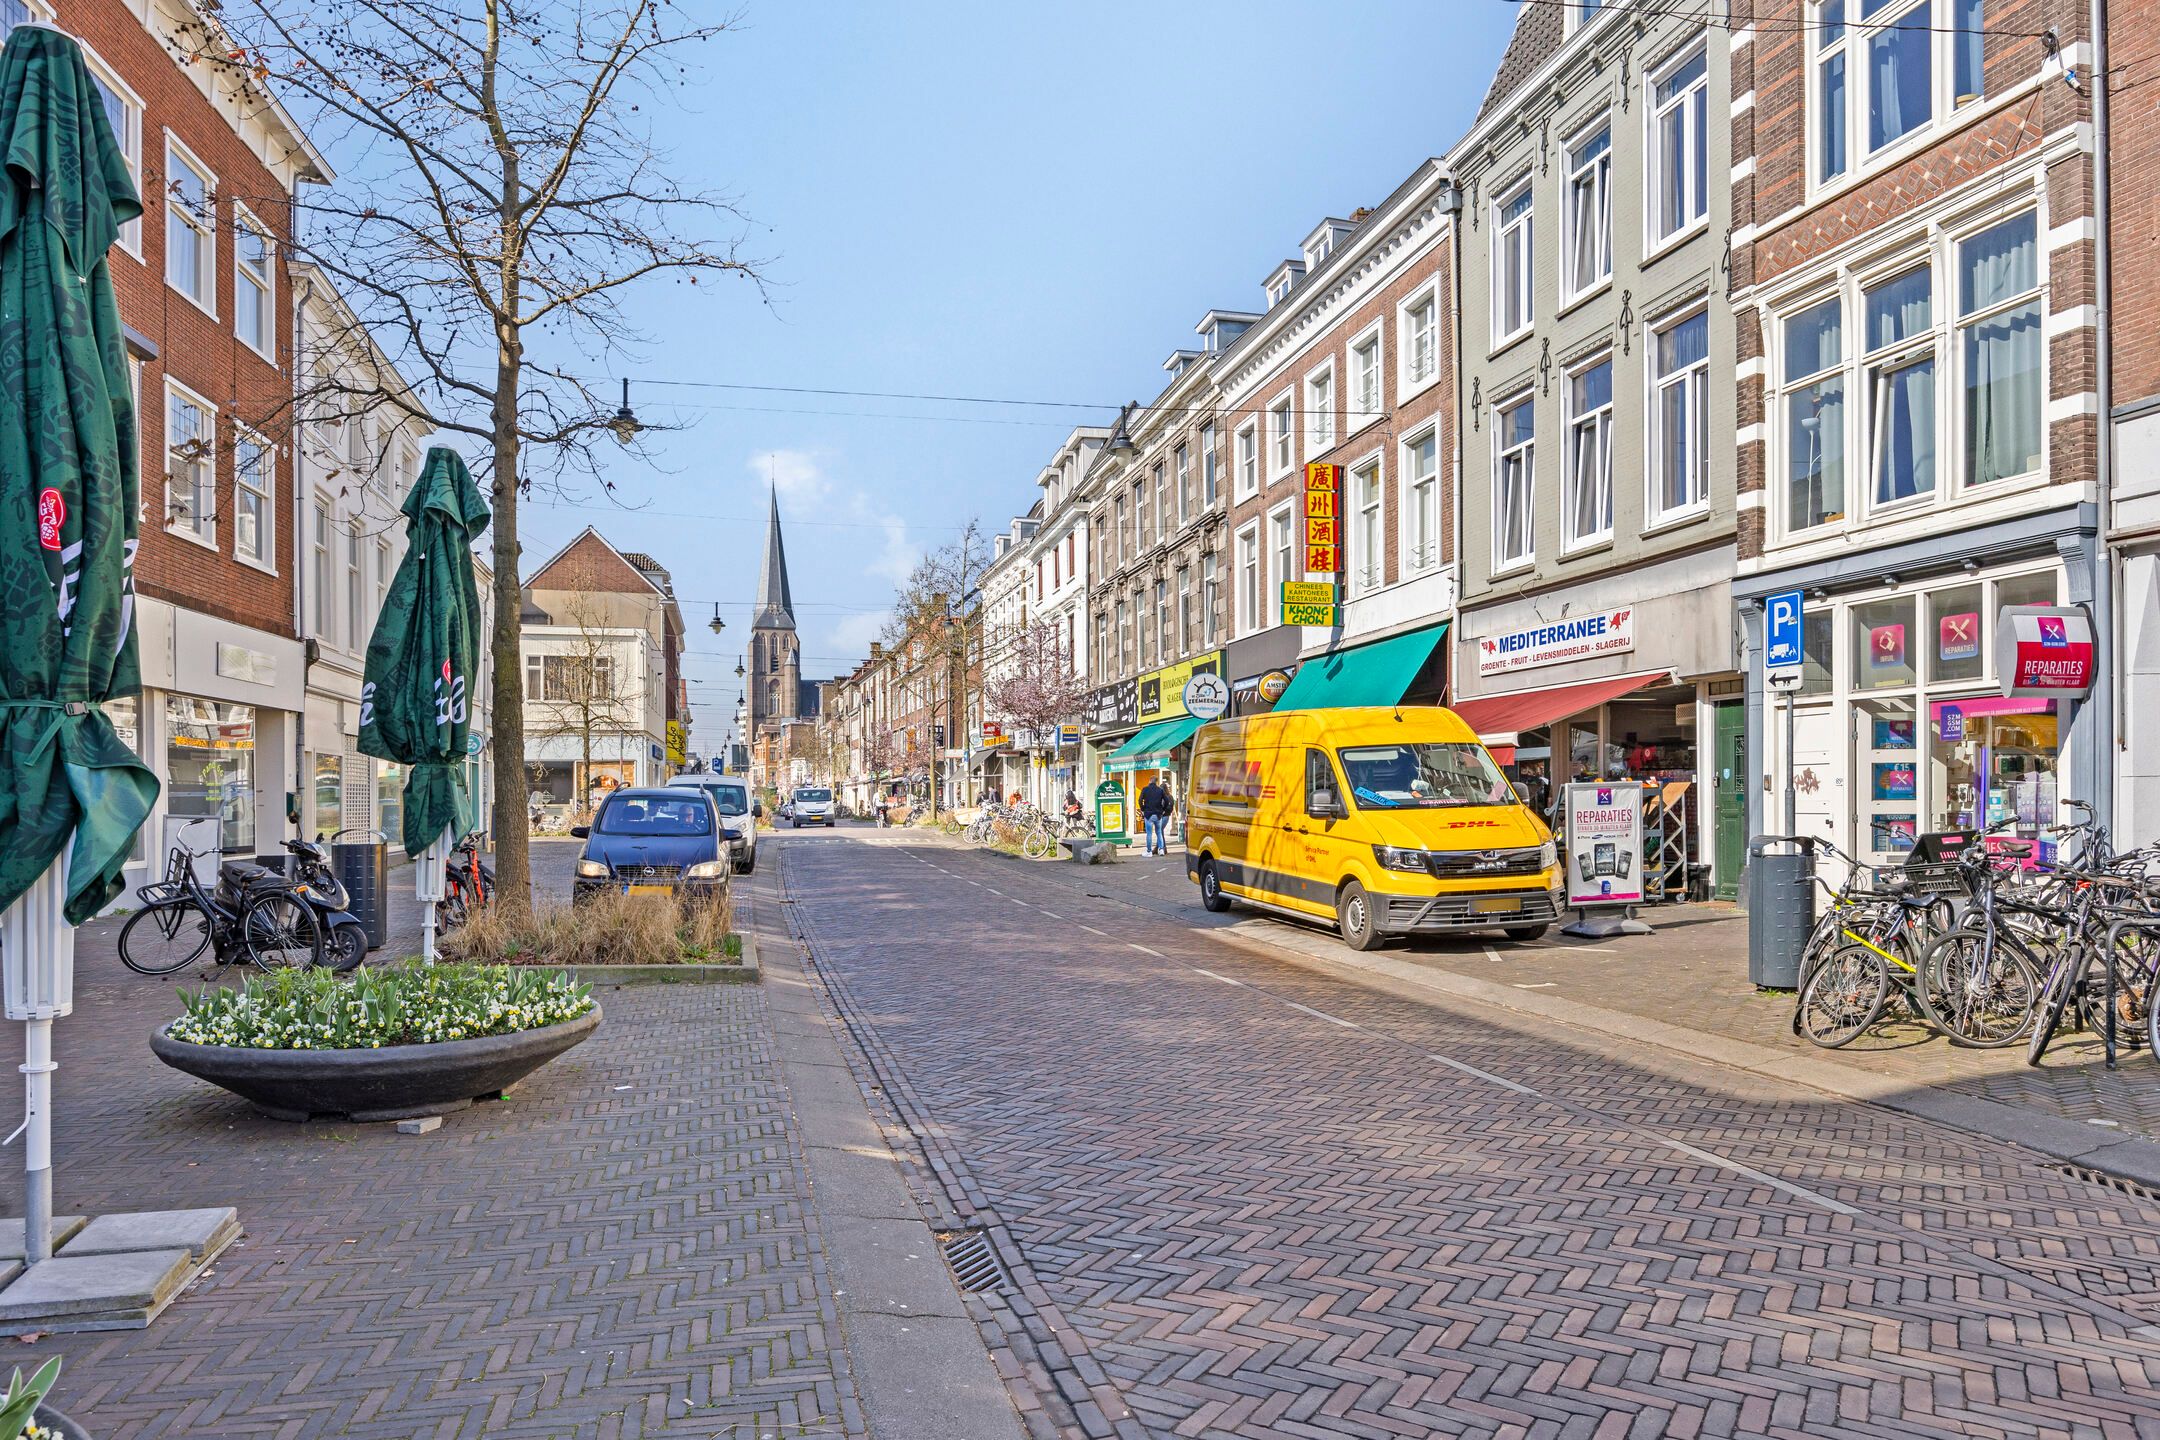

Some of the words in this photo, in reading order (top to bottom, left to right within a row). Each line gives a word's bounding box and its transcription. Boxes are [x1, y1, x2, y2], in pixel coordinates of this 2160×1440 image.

[1311, 464, 1332, 571] 廣州酒樓
[1289, 589, 1329, 597] KANTONEES
[1287, 595, 1331, 603] RESTAURANT
[1288, 604, 1329, 616] KWONG
[1292, 614, 1325, 625] CHOW
[1774, 601, 1792, 637] P
[1499, 616, 1606, 654] MEDITERRANEE
[1481, 660, 1507, 671] GROENTE
[1510, 656, 1529, 666] FRUIT
[1532, 644, 1590, 662] LEVENSMIDDELEN
[1595, 637, 1631, 651] SLAGERIJ
[1944, 644, 1975, 655] REPARATIES
[2024, 660, 2083, 675] REPARATIES
[1166, 691, 1183, 704] SLAGER
[1894, 763, 1910, 772] €15
[1204, 761, 1262, 798] DHL
[1369, 793, 1389, 804] JACK
[1576, 808, 1633, 824] REPARATIES
[1447, 821, 1500, 829] DHL
[1305, 845, 1317, 853] Service
[1317, 847, 1330, 856] Partner
[1473, 861, 1507, 870] MAN
